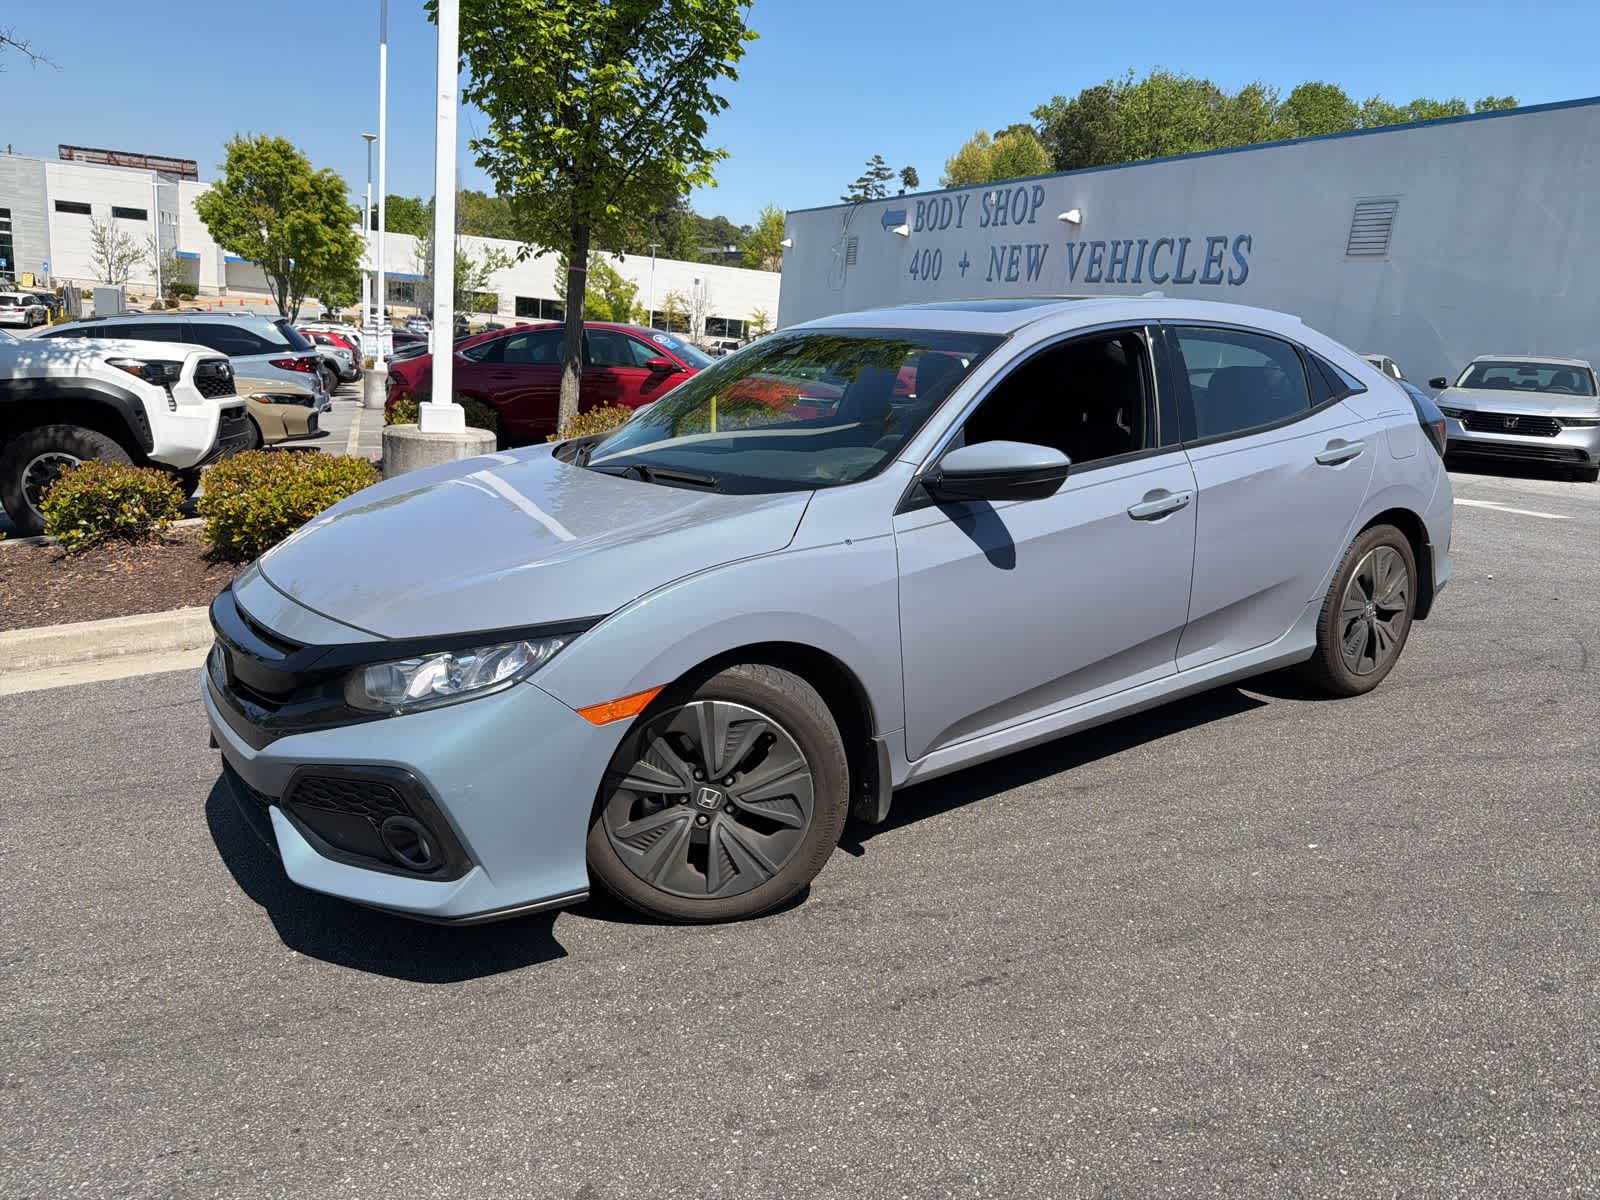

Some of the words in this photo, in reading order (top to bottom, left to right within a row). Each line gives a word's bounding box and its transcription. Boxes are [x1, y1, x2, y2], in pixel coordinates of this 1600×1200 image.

[913, 193, 970, 233] BODY
[980, 184, 1045, 228] SHOP
[909, 248, 943, 281] 400
[986, 243, 1049, 282] NEW
[1066, 233, 1252, 286] VEHICLES
